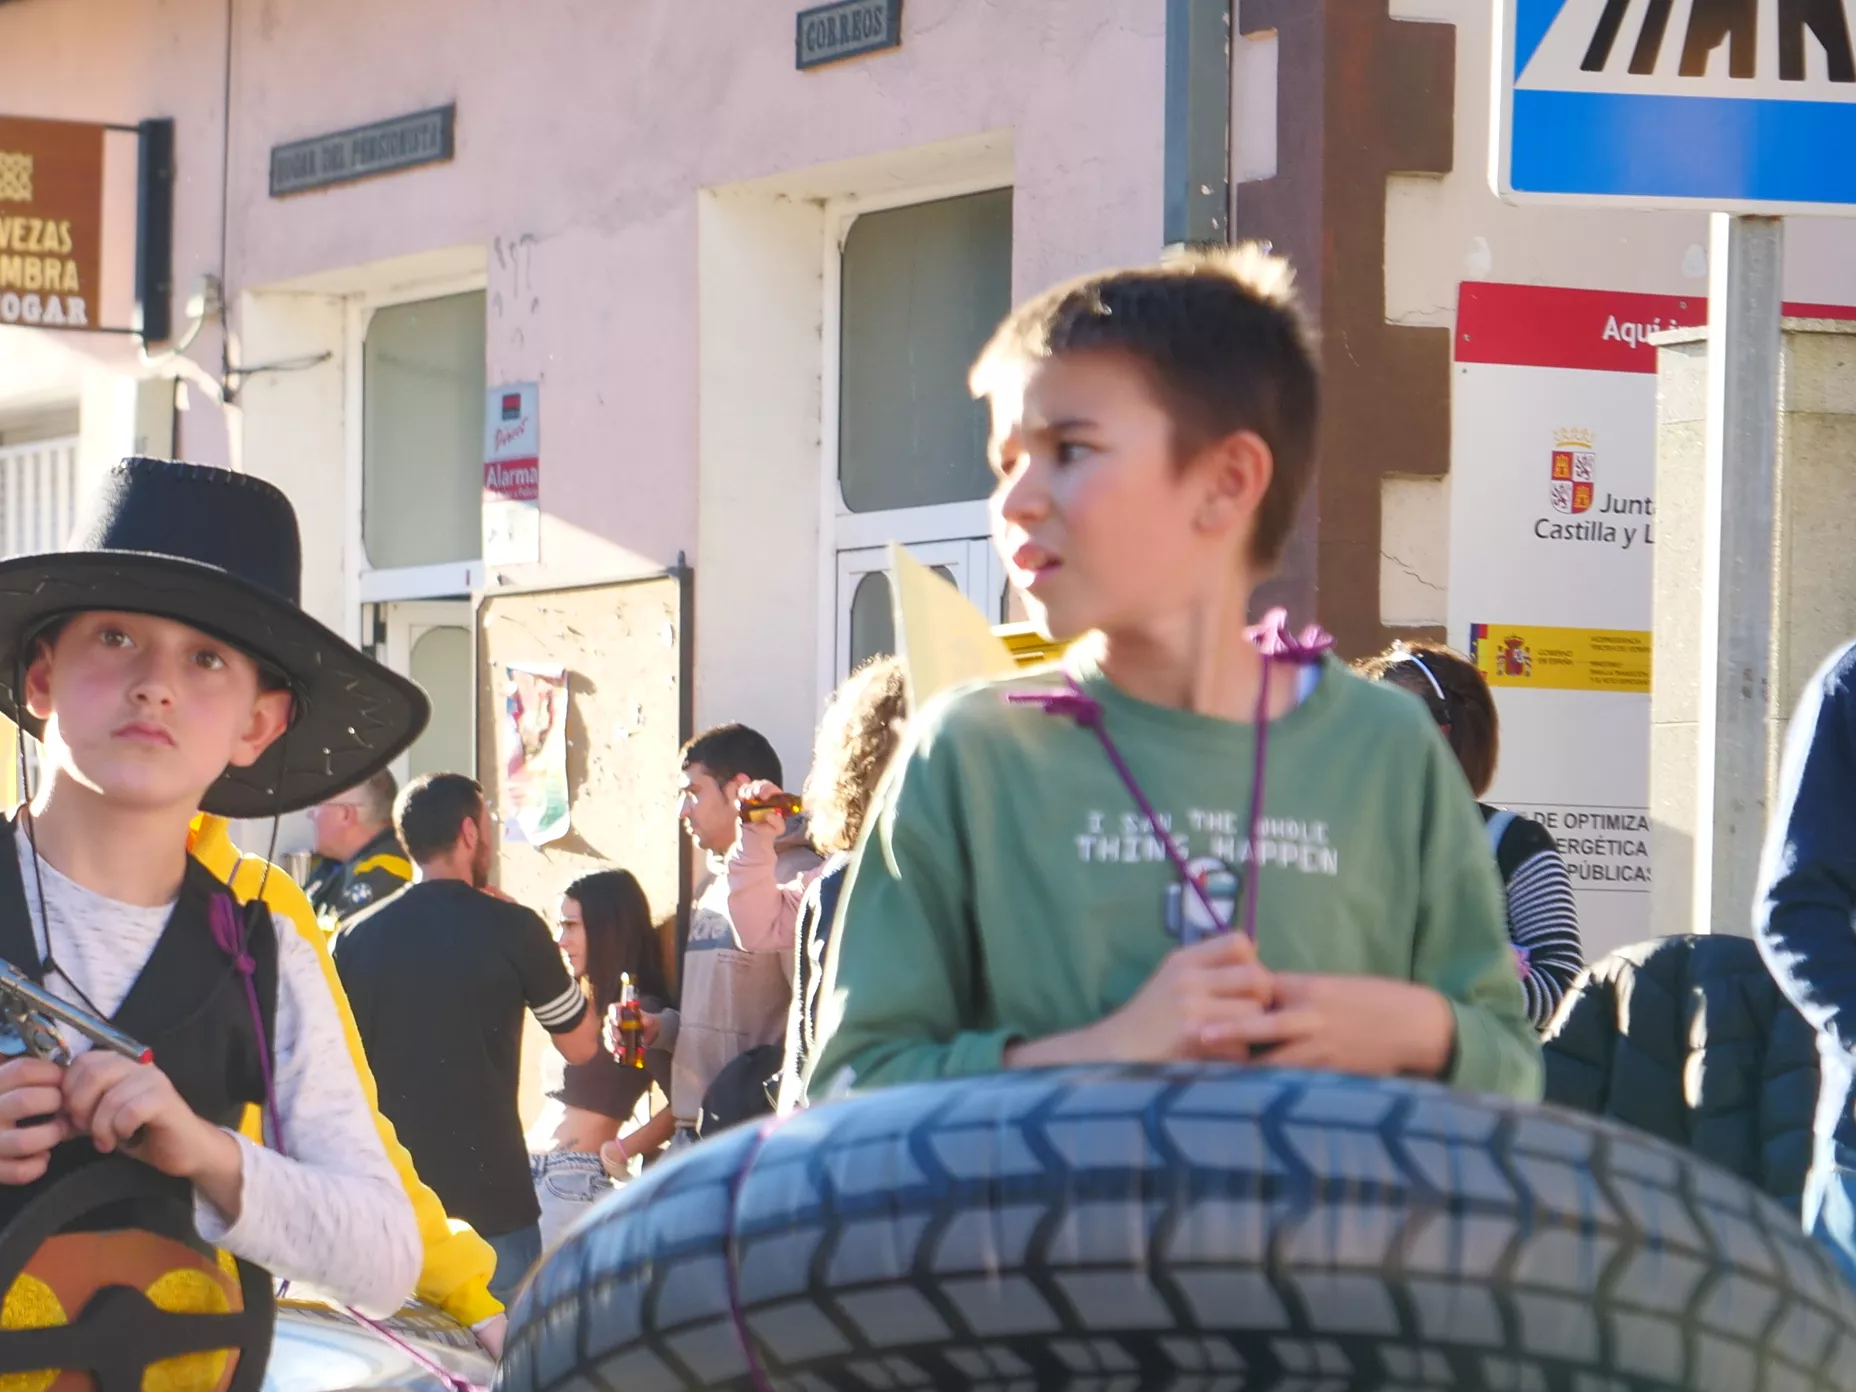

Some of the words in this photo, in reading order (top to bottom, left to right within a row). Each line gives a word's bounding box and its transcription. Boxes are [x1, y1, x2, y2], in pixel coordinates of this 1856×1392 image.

[807, 6, 883, 52] CORREOS
[487, 464, 538, 486] Alarma
[1599, 492, 1655, 516] Junt
[1534, 517, 1617, 543] Castilla
[1621, 527, 1637, 549] y
[1088, 810, 1105, 834] I
[1187, 807, 1238, 835] THE
[1534, 811, 1559, 829] DE
[1564, 812, 1650, 832] OPTIMIZA
[1074, 833, 1191, 864] THING
[1210, 836, 1339, 876] HAPPEN
